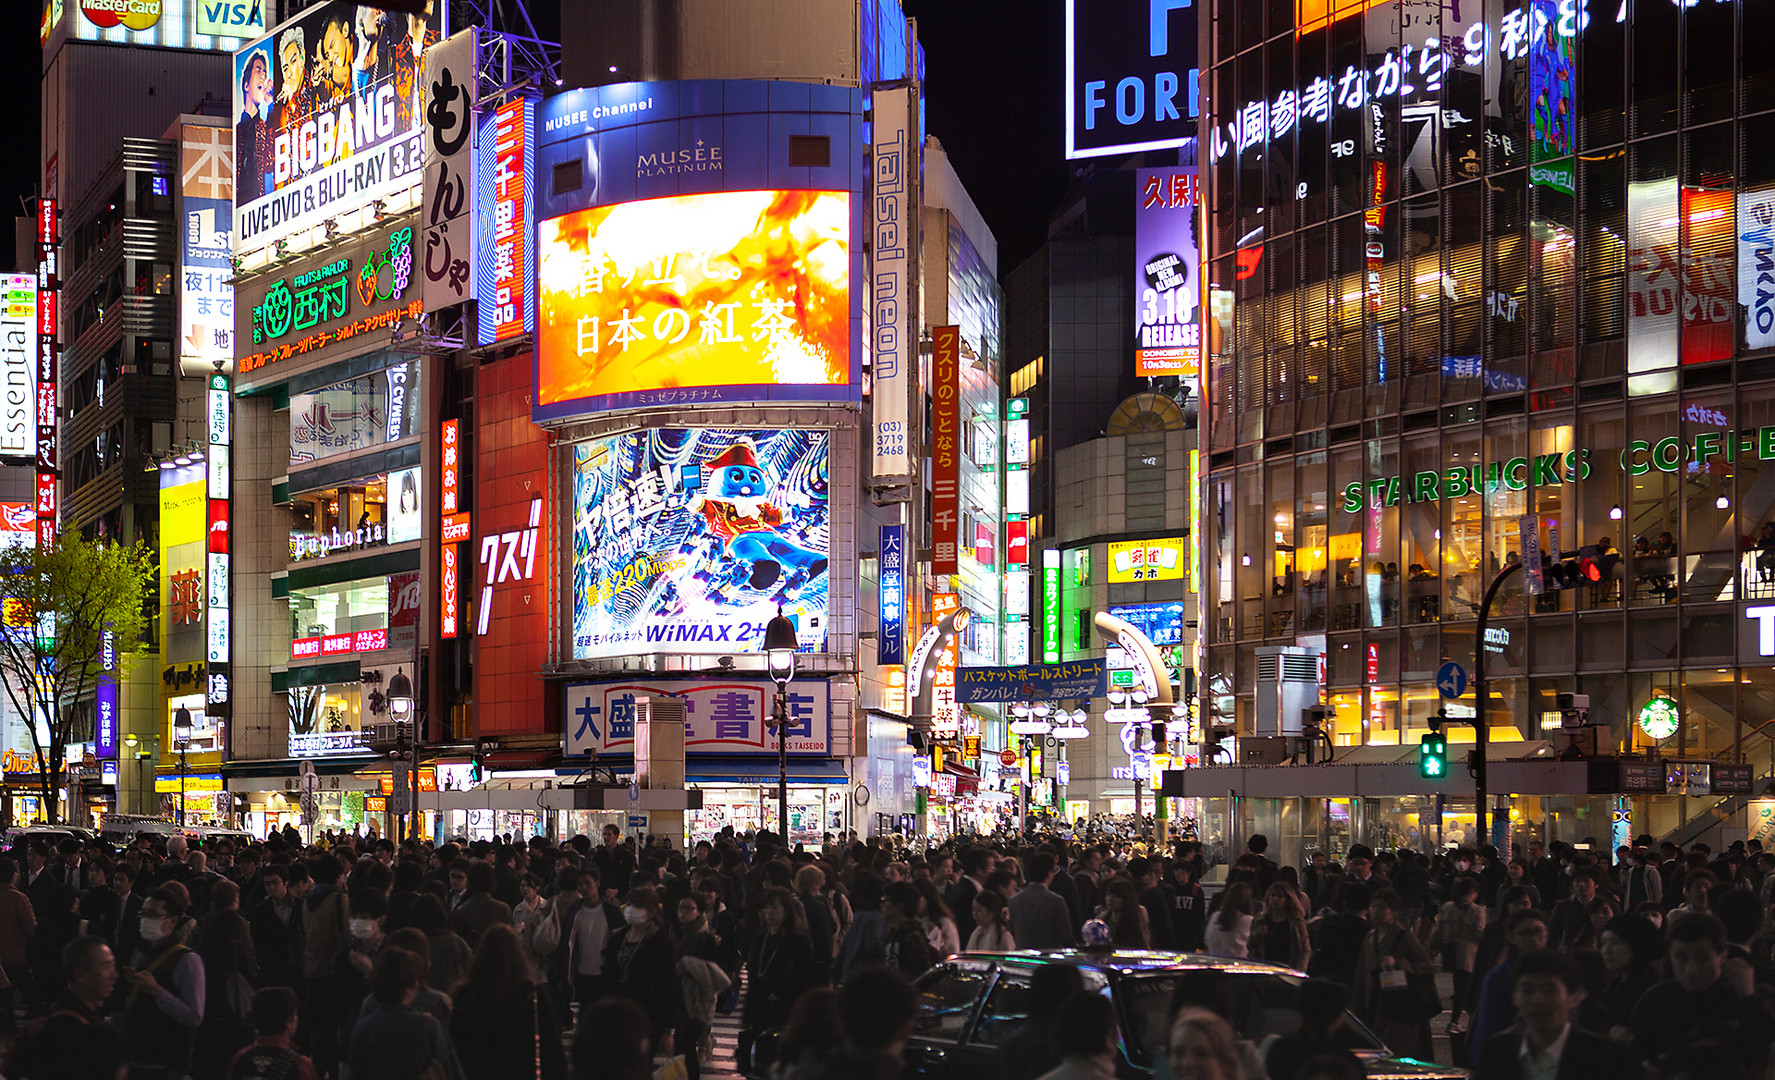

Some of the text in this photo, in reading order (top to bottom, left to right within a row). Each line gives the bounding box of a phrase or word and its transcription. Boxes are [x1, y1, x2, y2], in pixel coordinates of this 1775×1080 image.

[81, 0, 160, 15] MasterCard
[205, 4, 263, 27] VISA
[1209, 0, 1627, 159] い風参考ながら9秒8
[545, 98, 653, 132] MUSEE Channel
[274, 83, 396, 186] BIGBANG
[183, 128, 233, 200] 本
[637, 161, 723, 178] PLATINUM
[241, 152, 386, 241] LIVE DVD & BLU-RAY
[426, 68, 471, 297] もんじゃ
[876, 129, 905, 262] Taisei
[188, 211, 200, 245] BOOK
[492, 110, 516, 326] 三千里薬品
[1145, 254, 1181, 277] ORIGINAL
[1157, 266, 1175, 282] NEW
[197, 297, 232, 317] まで
[293, 275, 349, 331] 西村
[1142, 287, 1193, 326] 3.18
[214, 328, 235, 349] 地
[576, 297, 797, 358] 日本の紅茶
[875, 270, 898, 380] neon
[1142, 322, 1200, 348] RELEASE
[1142, 350, 1185, 358] CONCERT
[0, 320, 27, 451] Essential
[637, 388, 722, 403] ミュゼプラチナム
[935, 333, 956, 468] クスリのことなら
[876, 434, 904, 446] 3719
[878, 421, 902, 433] (03)
[876, 446, 904, 457] 2468
[1343, 448, 1592, 514] STARBUCKS
[934, 480, 957, 563] 三千里
[293, 524, 384, 558] Euphoria
[477, 498, 543, 636] クスリ
[170, 567, 203, 625] 薬
[323, 637, 352, 652] 海外旅行
[356, 630, 385, 642] ハネムーン
[646, 621, 766, 643] WiMAX 2+
[293, 640, 320, 656] 国内旅行
[963, 663, 1102, 683] バスケットボールストリート
[969, 687, 1018, 700] ガンバレ!
[771, 742, 825, 750] BOKS TAISEIDO
